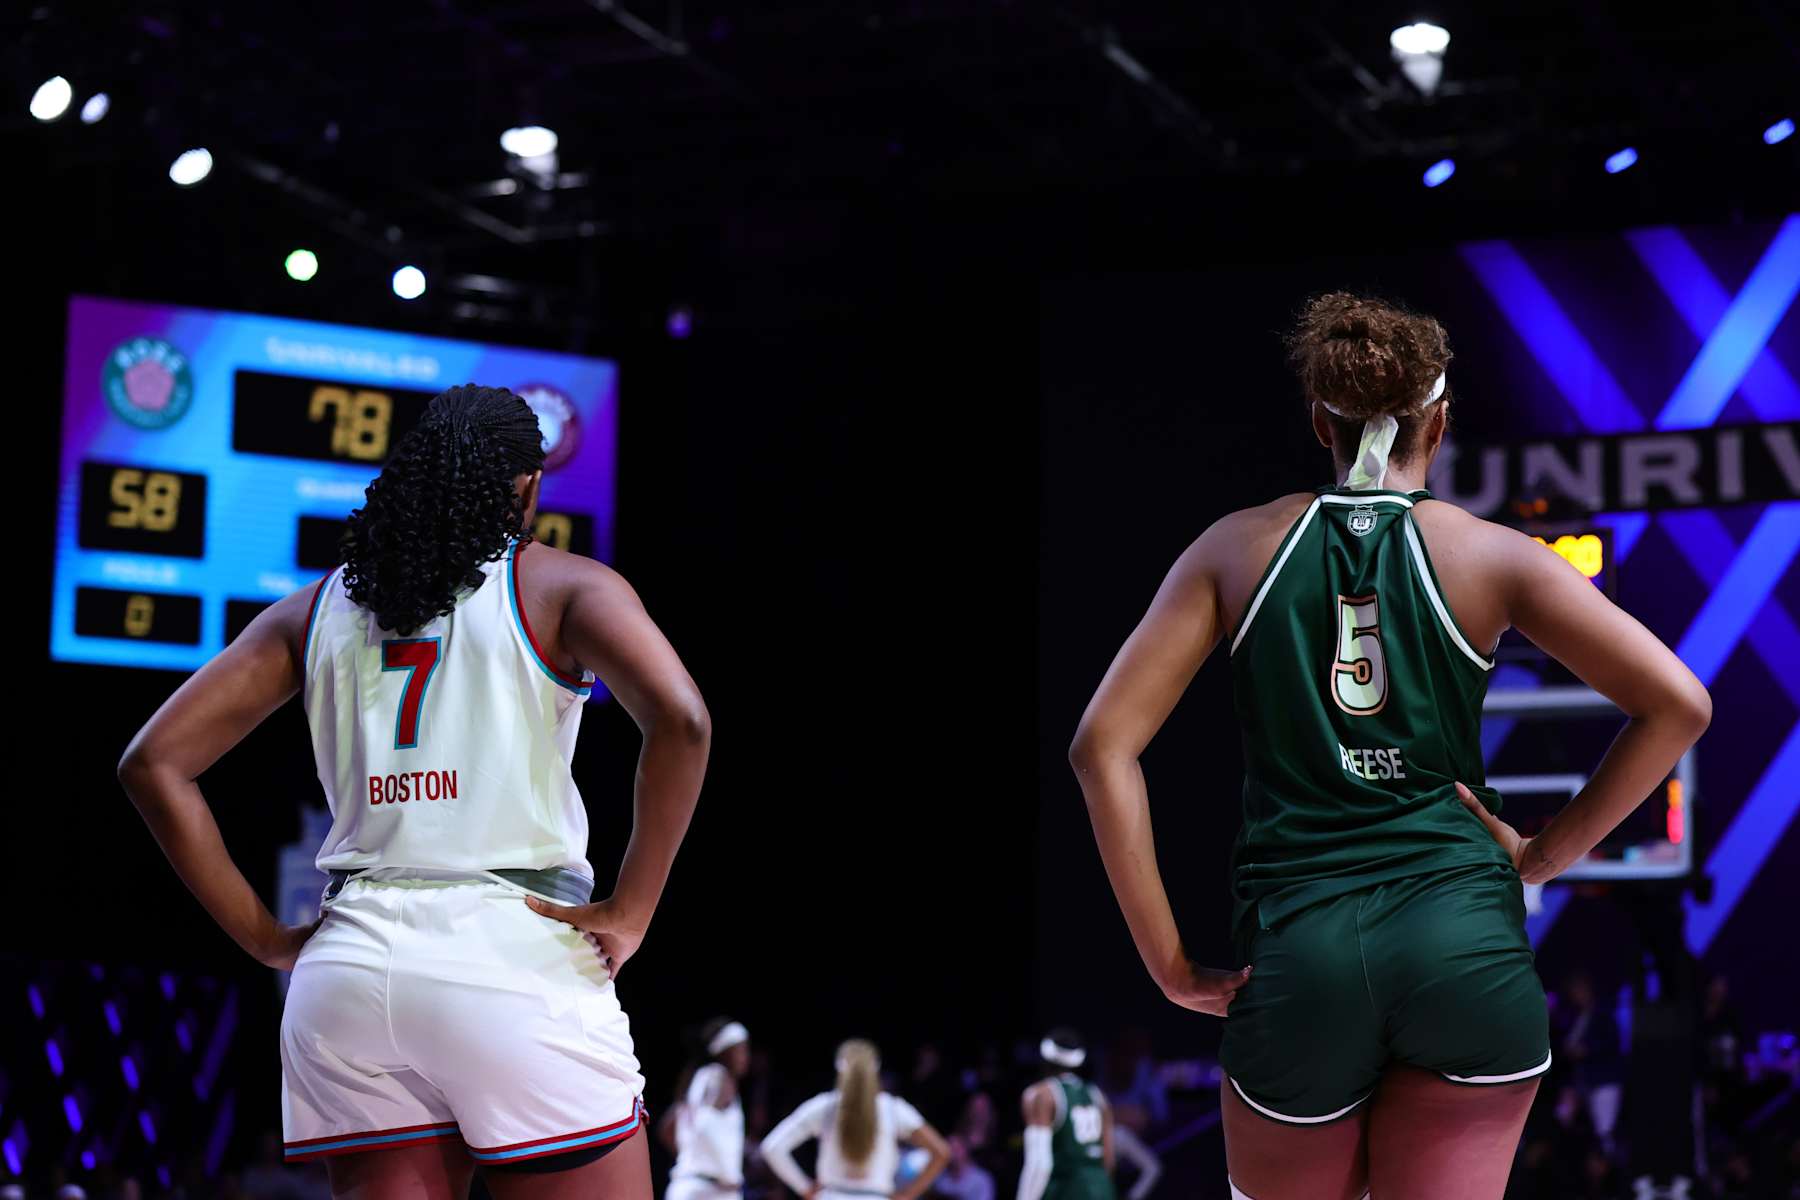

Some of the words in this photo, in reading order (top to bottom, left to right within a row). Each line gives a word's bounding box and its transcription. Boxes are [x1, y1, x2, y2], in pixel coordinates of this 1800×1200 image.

[308, 386, 392, 460] 78
[108, 469, 182, 532] 58
[1331, 594, 1388, 716] 5
[382, 636, 442, 750] 7
[369, 769, 458, 806] BOSTON
[1338, 742, 1406, 780] REESE
